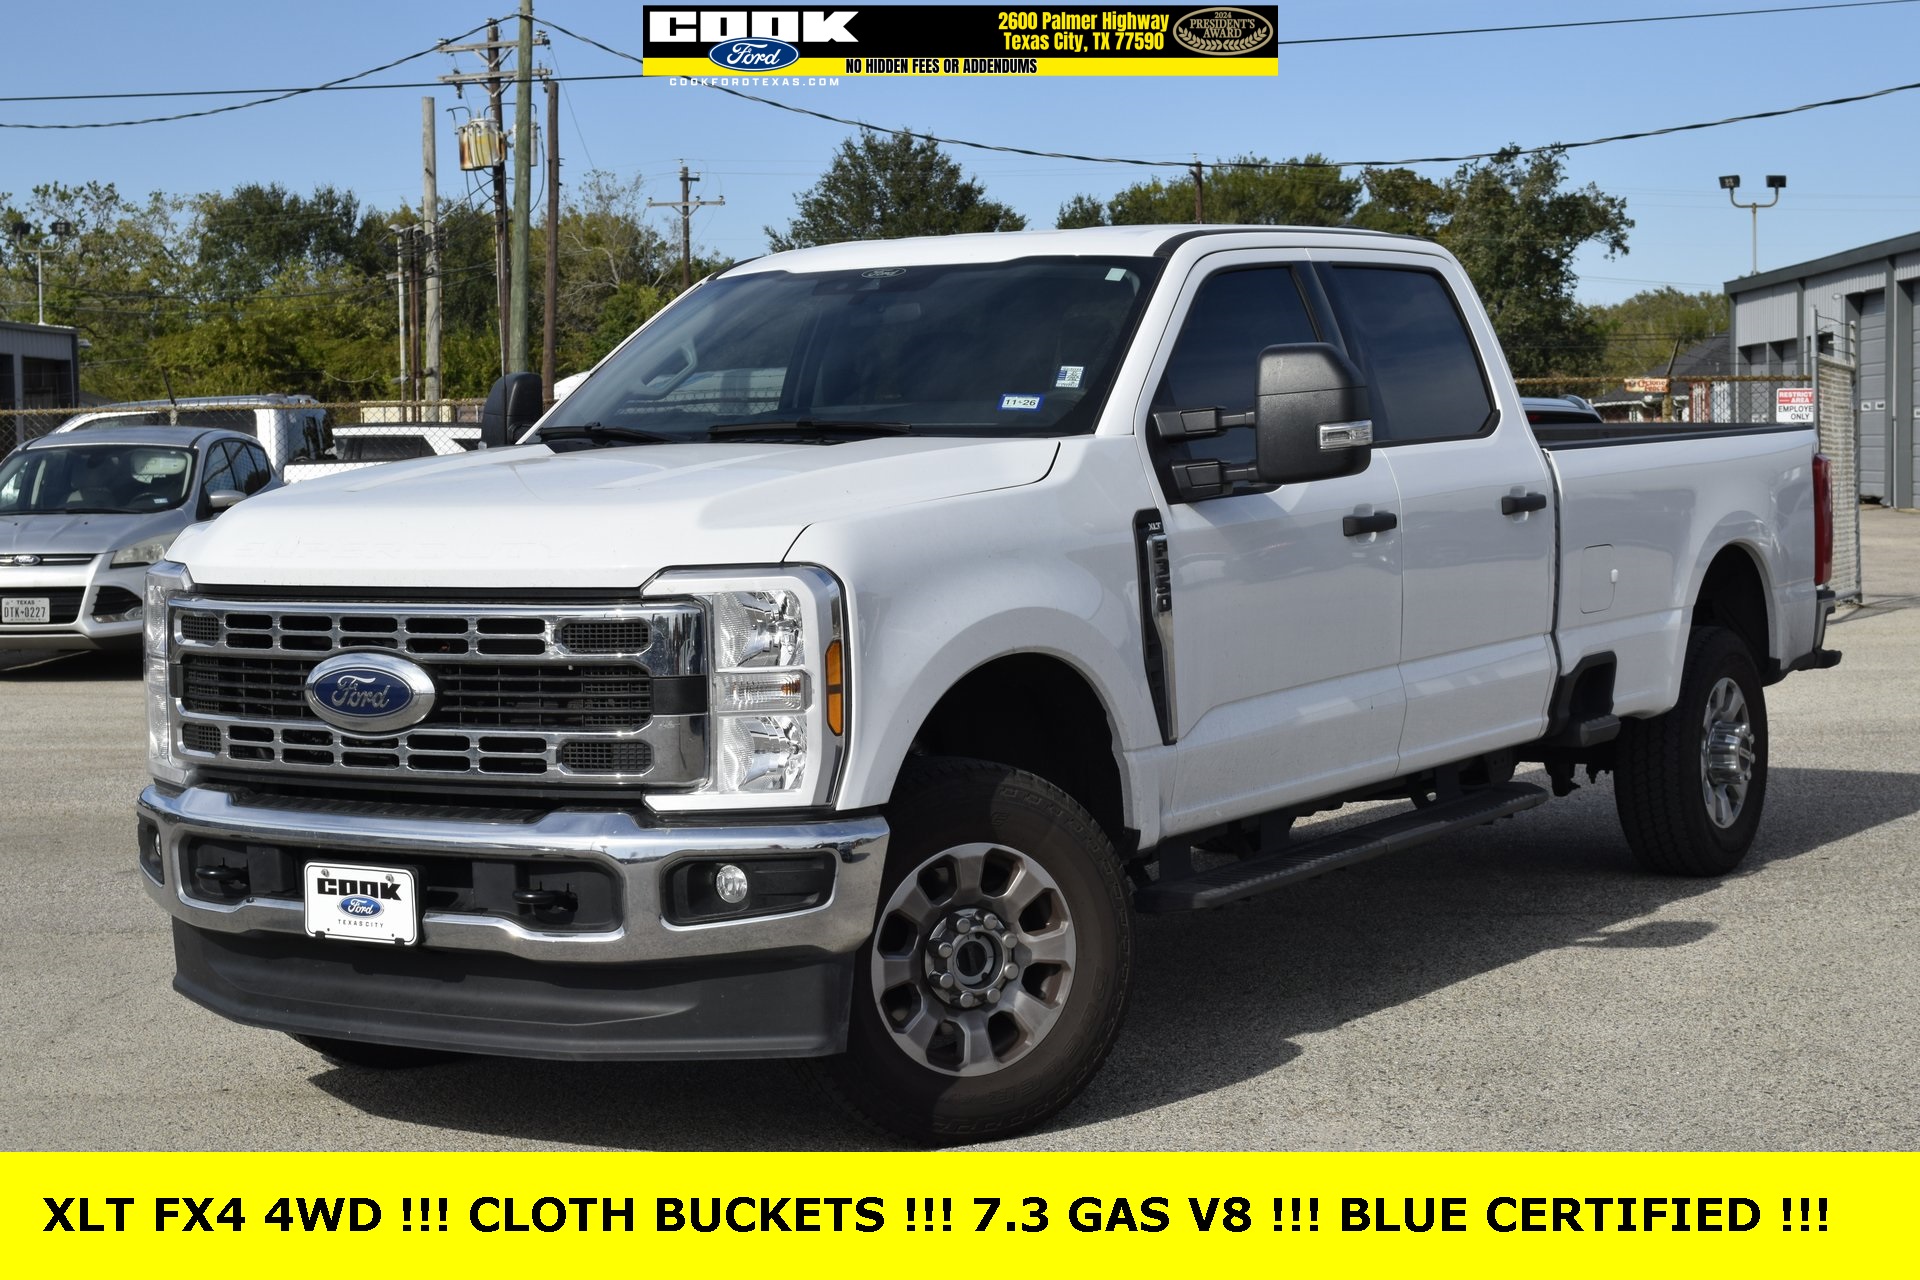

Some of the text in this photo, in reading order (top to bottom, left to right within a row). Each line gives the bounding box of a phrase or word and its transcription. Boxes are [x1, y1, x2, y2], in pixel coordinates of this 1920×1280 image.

[1778, 405, 1814, 413] EMPLOYE
[1148, 522, 1162, 531] XLT
[331, 675, 391, 708] Ford
[316, 877, 402, 901] COOK
[347, 898, 374, 915] Ford
[338, 919, 363, 927] TEXAS
